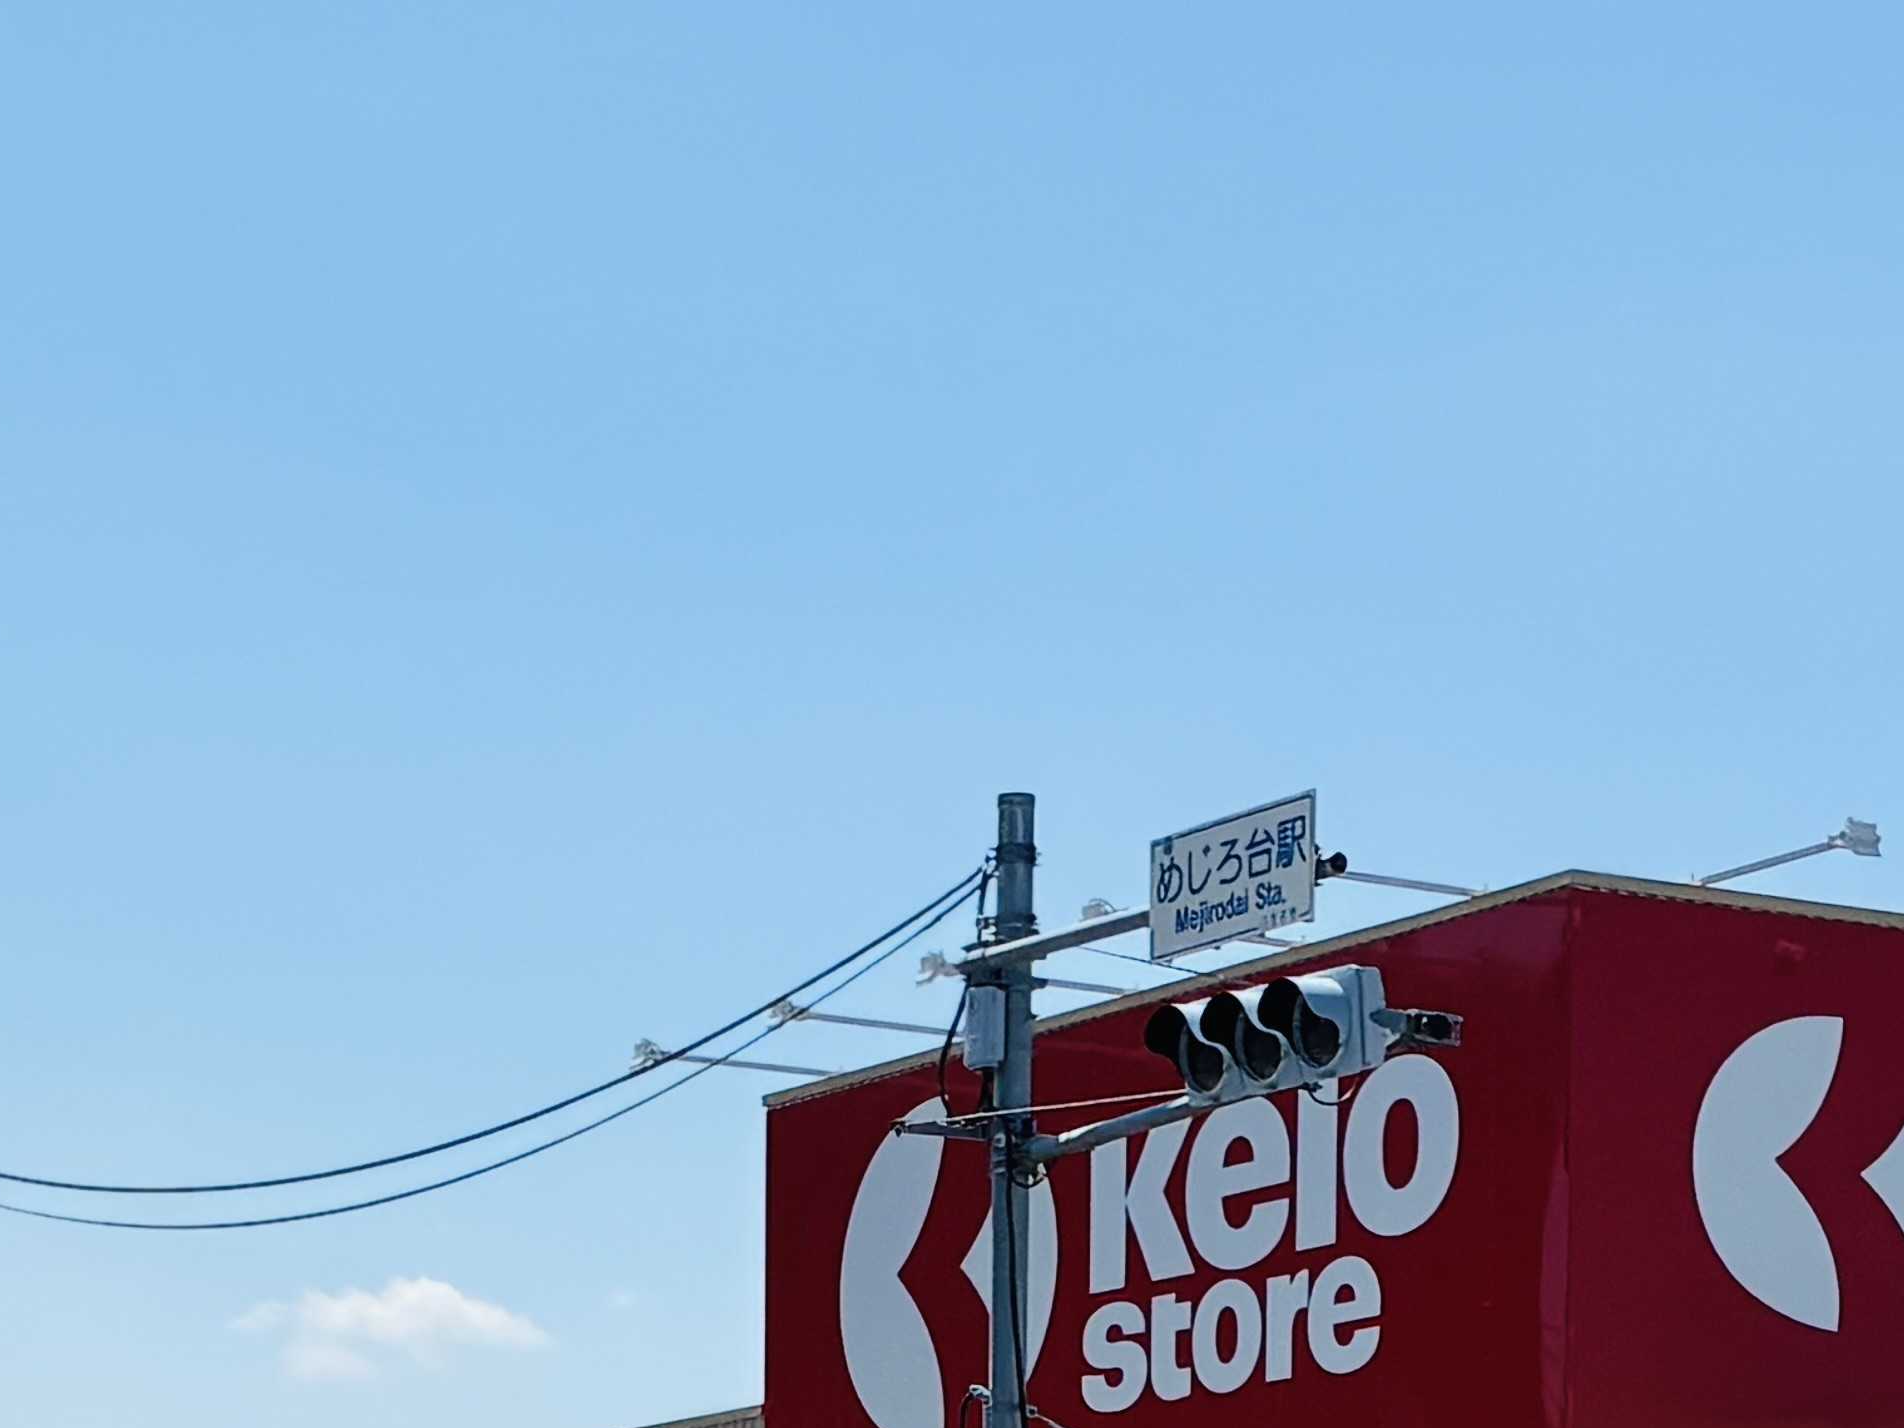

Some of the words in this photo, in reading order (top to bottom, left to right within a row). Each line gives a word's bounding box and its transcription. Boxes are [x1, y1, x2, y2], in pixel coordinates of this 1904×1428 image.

[1156, 815, 1306, 904] めじろ台駅
[1175, 888, 1248, 934] Mejirodai
[1255, 881, 1286, 909] Sta.
[1081, 1255, 1382, 1413] store
